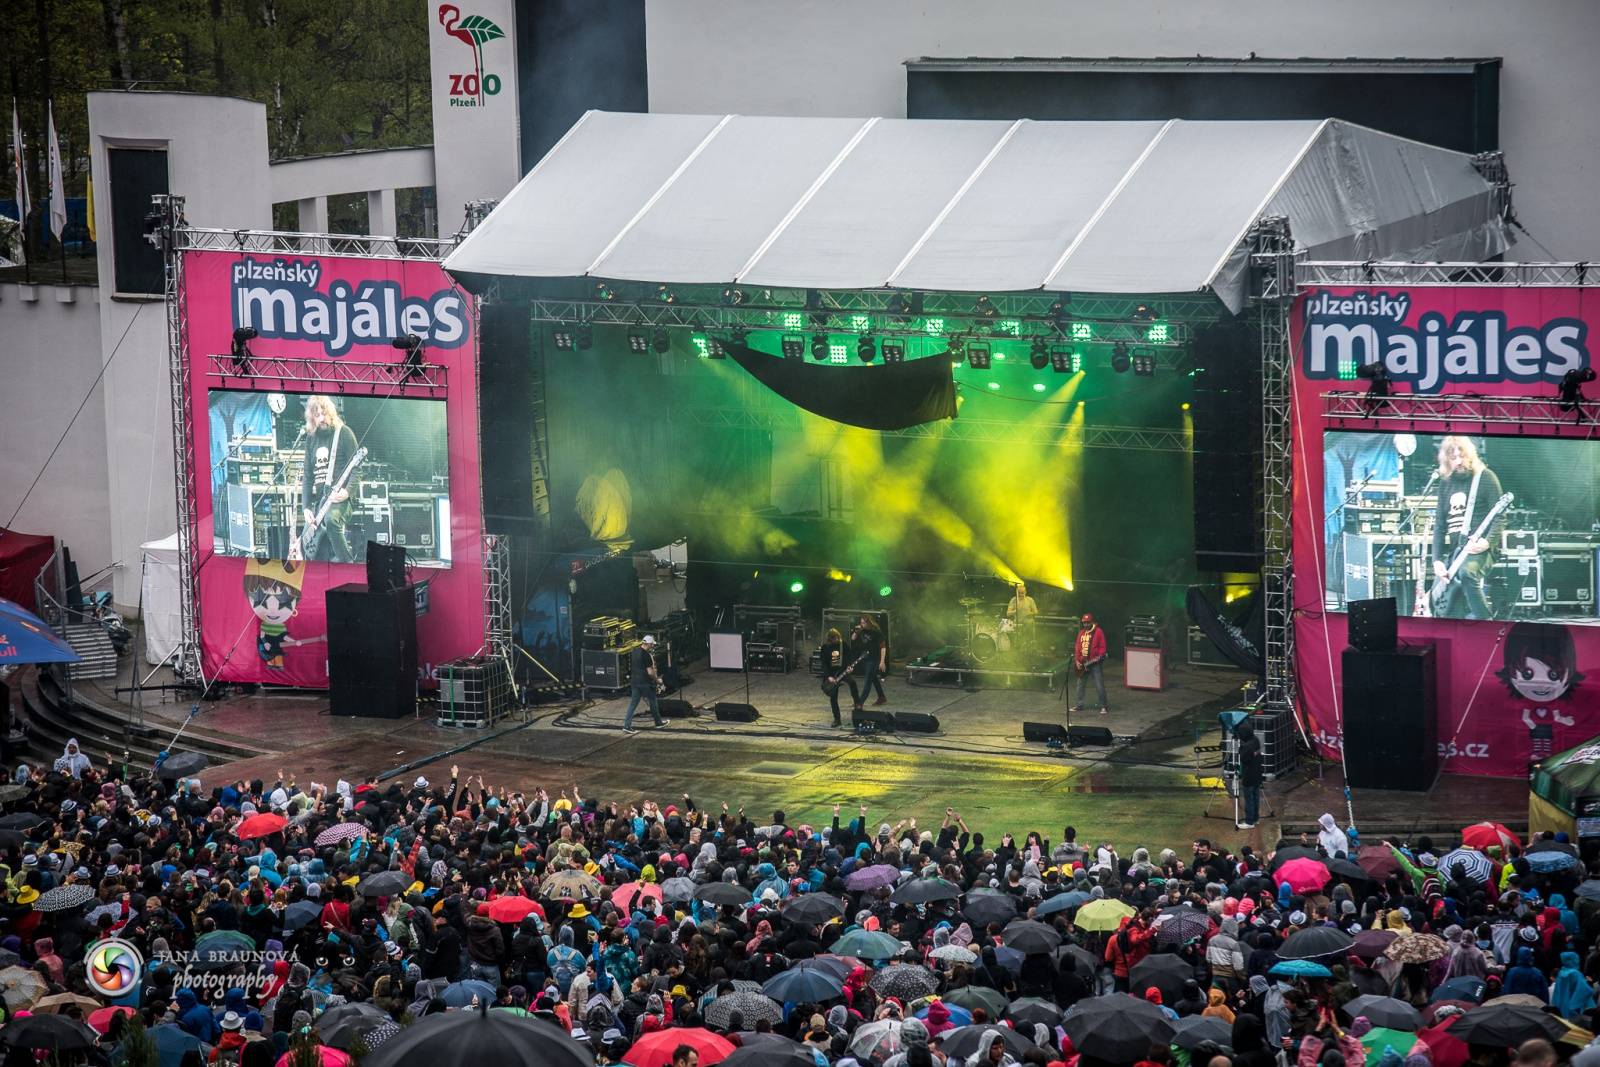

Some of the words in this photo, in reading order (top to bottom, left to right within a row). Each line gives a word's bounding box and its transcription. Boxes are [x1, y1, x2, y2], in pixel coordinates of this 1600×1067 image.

[450, 97, 476, 107] Plzeň
[234, 260, 318, 287] plzeňský
[1306, 294, 1408, 322] plzeňský
